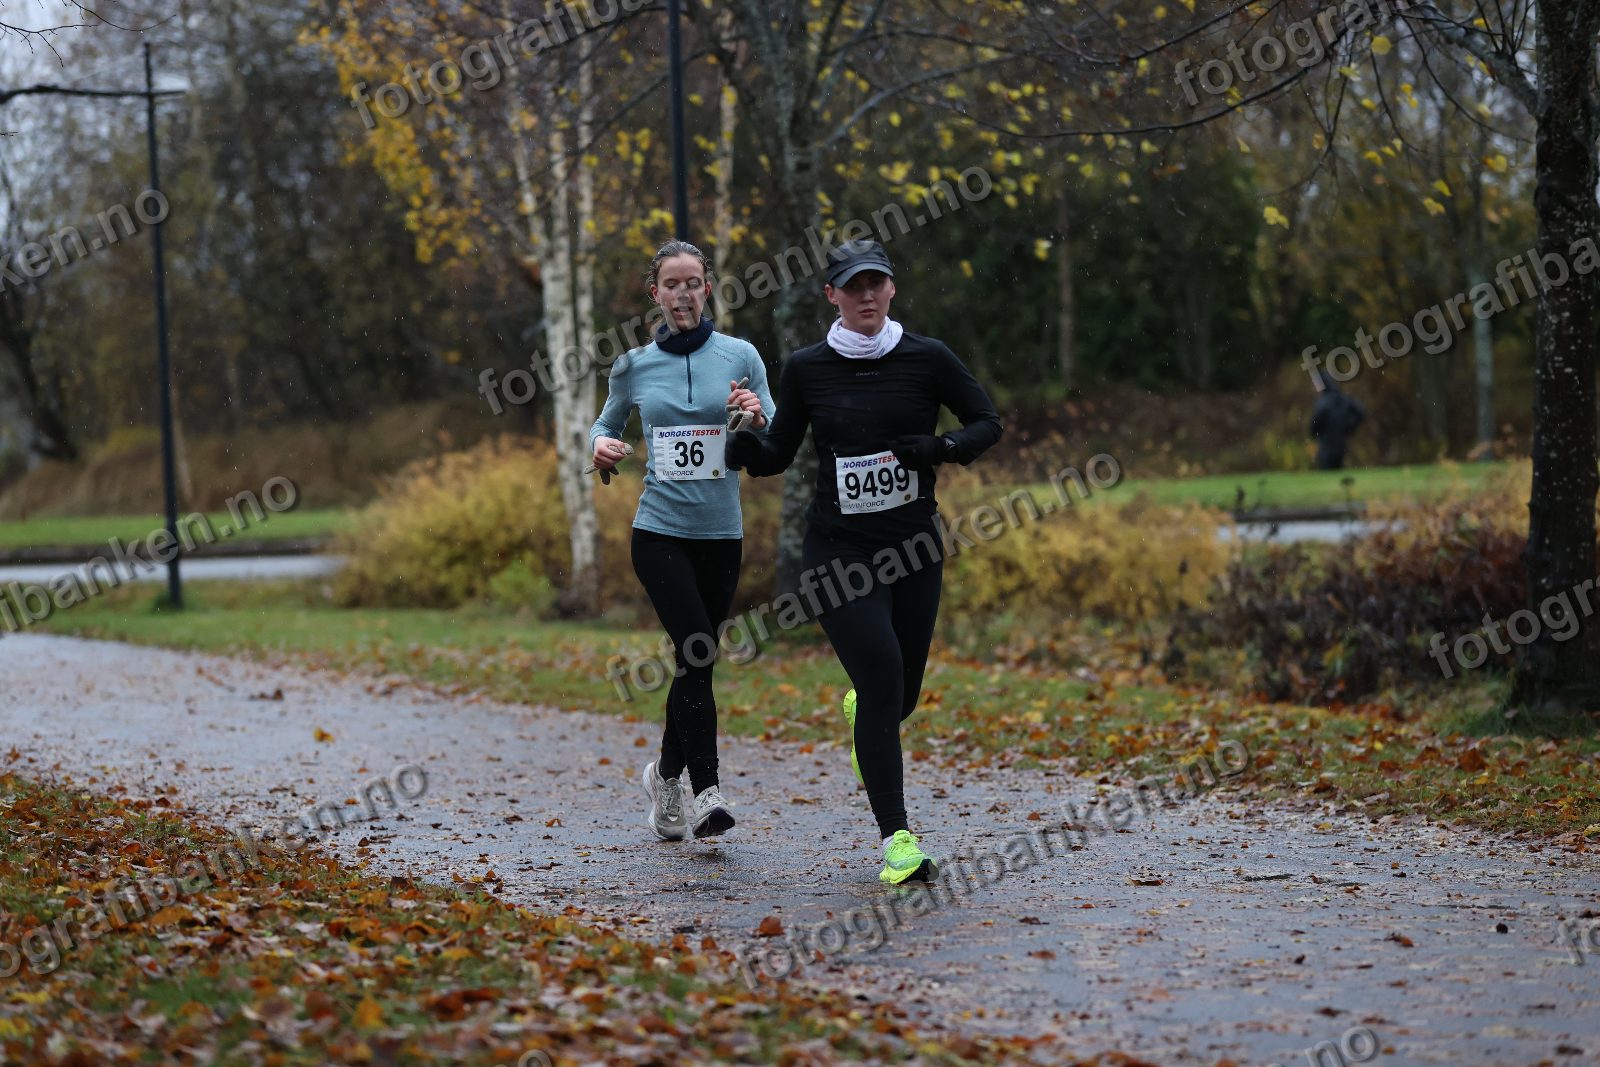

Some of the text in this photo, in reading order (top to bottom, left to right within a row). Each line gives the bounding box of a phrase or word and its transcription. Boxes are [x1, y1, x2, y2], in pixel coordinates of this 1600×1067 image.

[658, 429, 721, 438] NORGESTESTEN
[674, 440, 704, 467] 36
[845, 464, 909, 500] 9499
[848, 500, 885, 509] WINFORCE
